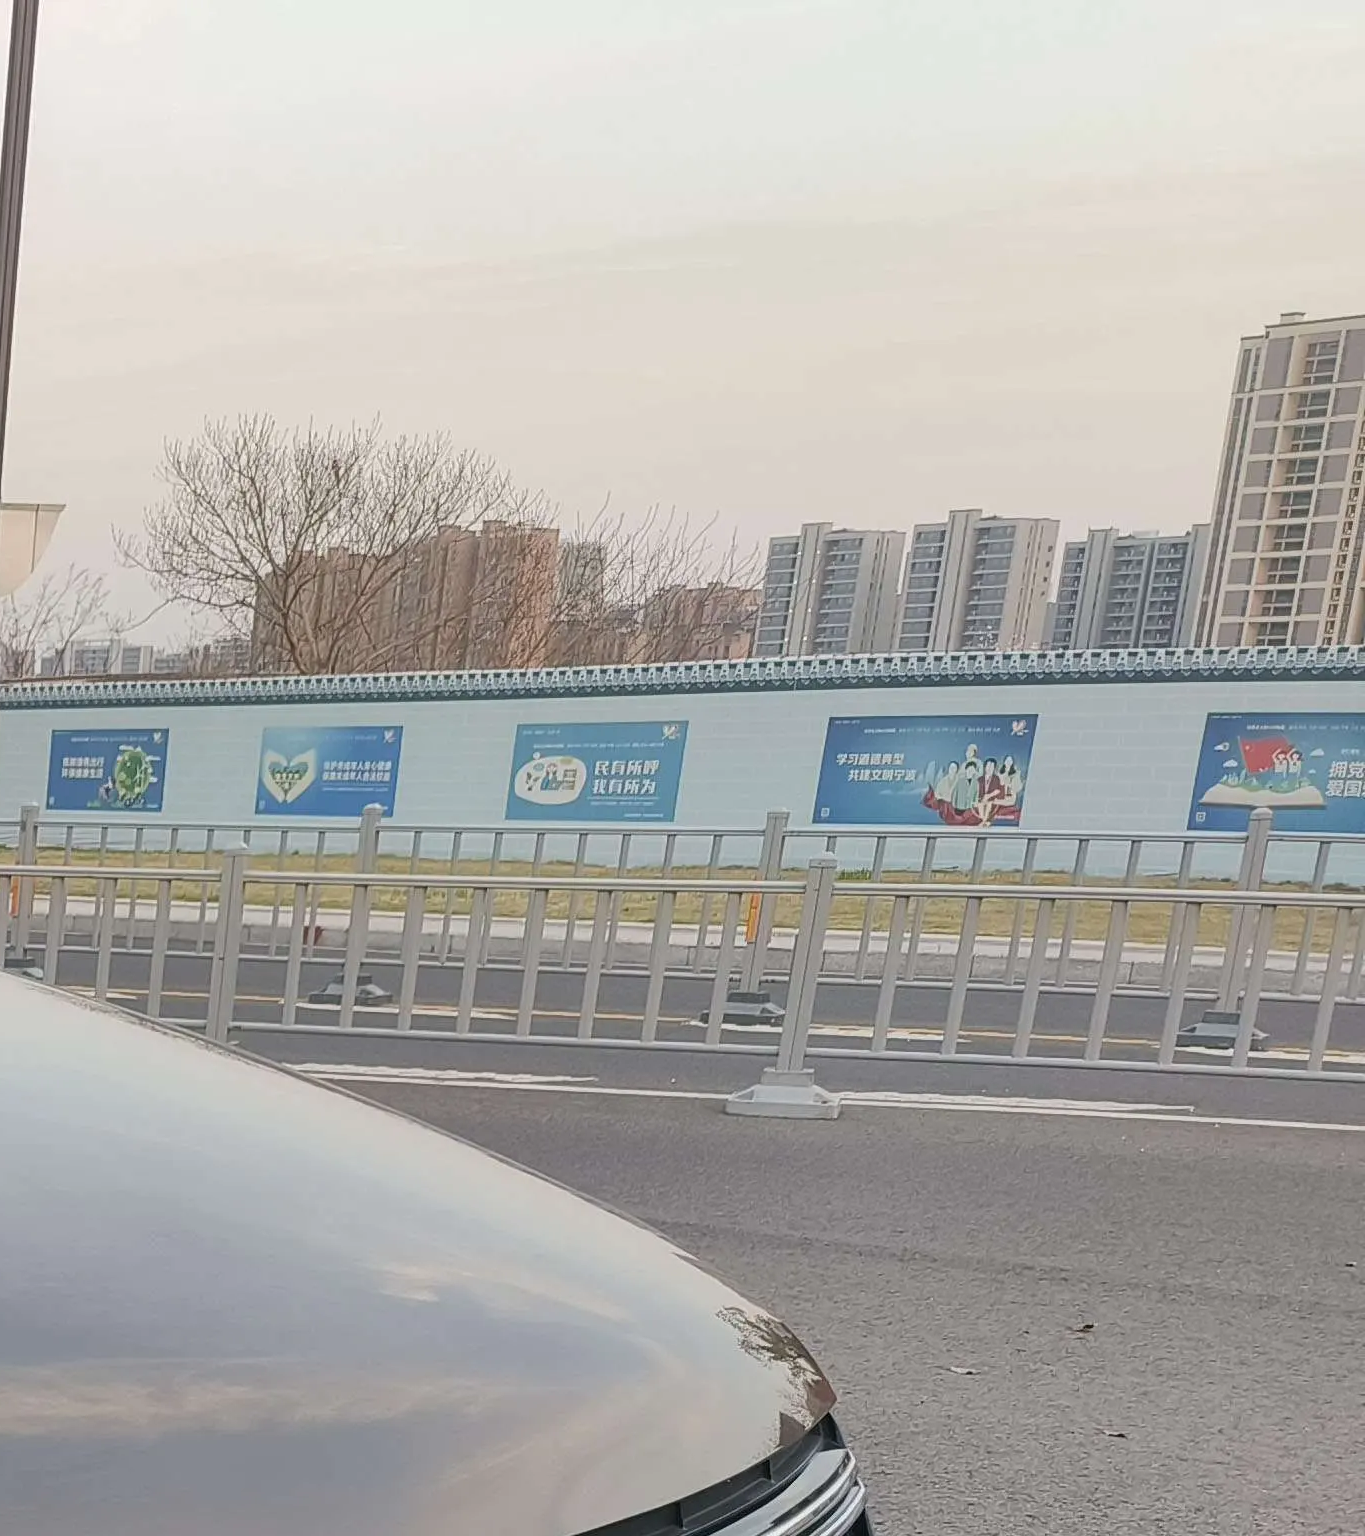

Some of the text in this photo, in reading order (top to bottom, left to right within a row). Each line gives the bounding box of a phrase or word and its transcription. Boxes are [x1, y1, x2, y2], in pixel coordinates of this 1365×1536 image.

[836, 753, 905, 766] 学习道德典型
[594, 760, 660, 776] 民有所呼
[847, 769, 917, 782] 共建文明宁波
[592, 779, 657, 795] 我有所为
[1325, 779, 1365, 798] 爱国
